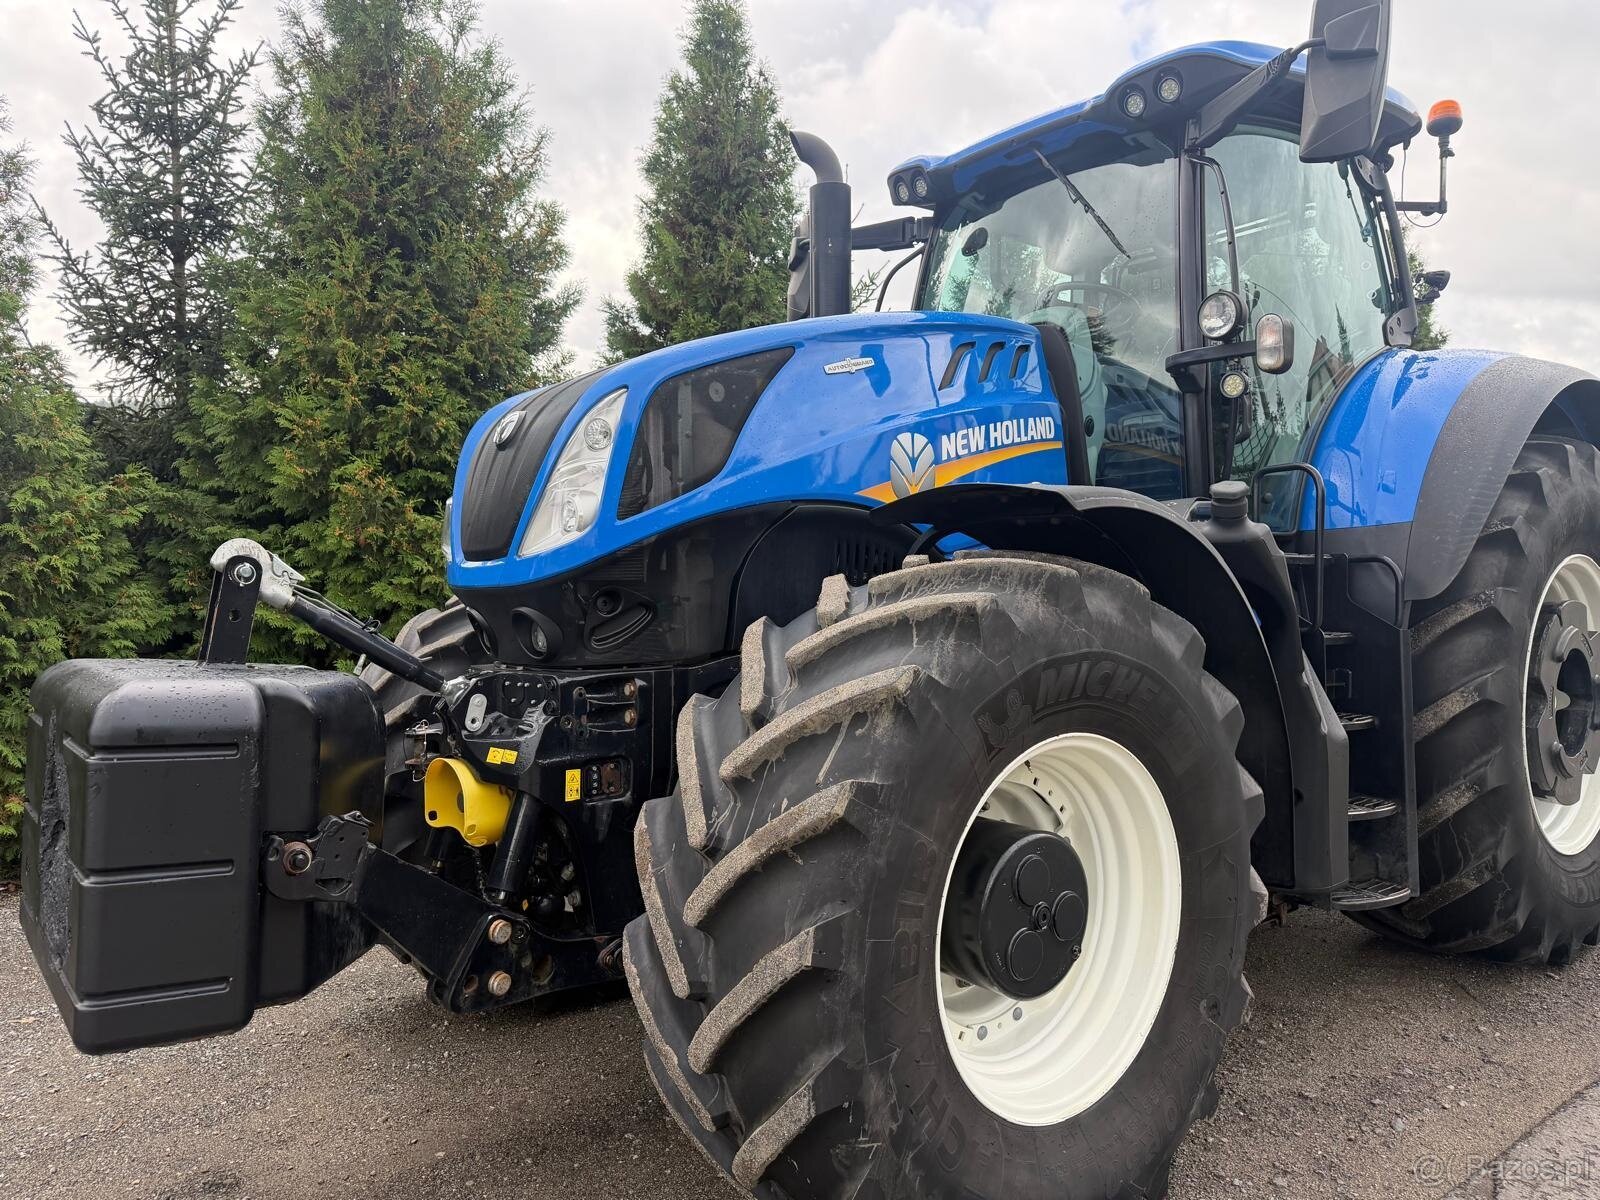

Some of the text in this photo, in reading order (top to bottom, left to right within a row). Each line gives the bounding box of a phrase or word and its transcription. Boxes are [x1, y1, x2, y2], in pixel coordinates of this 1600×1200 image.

[941, 416, 1055, 461] NEW HOLLAND
[1034, 659, 1164, 713] MICHE
